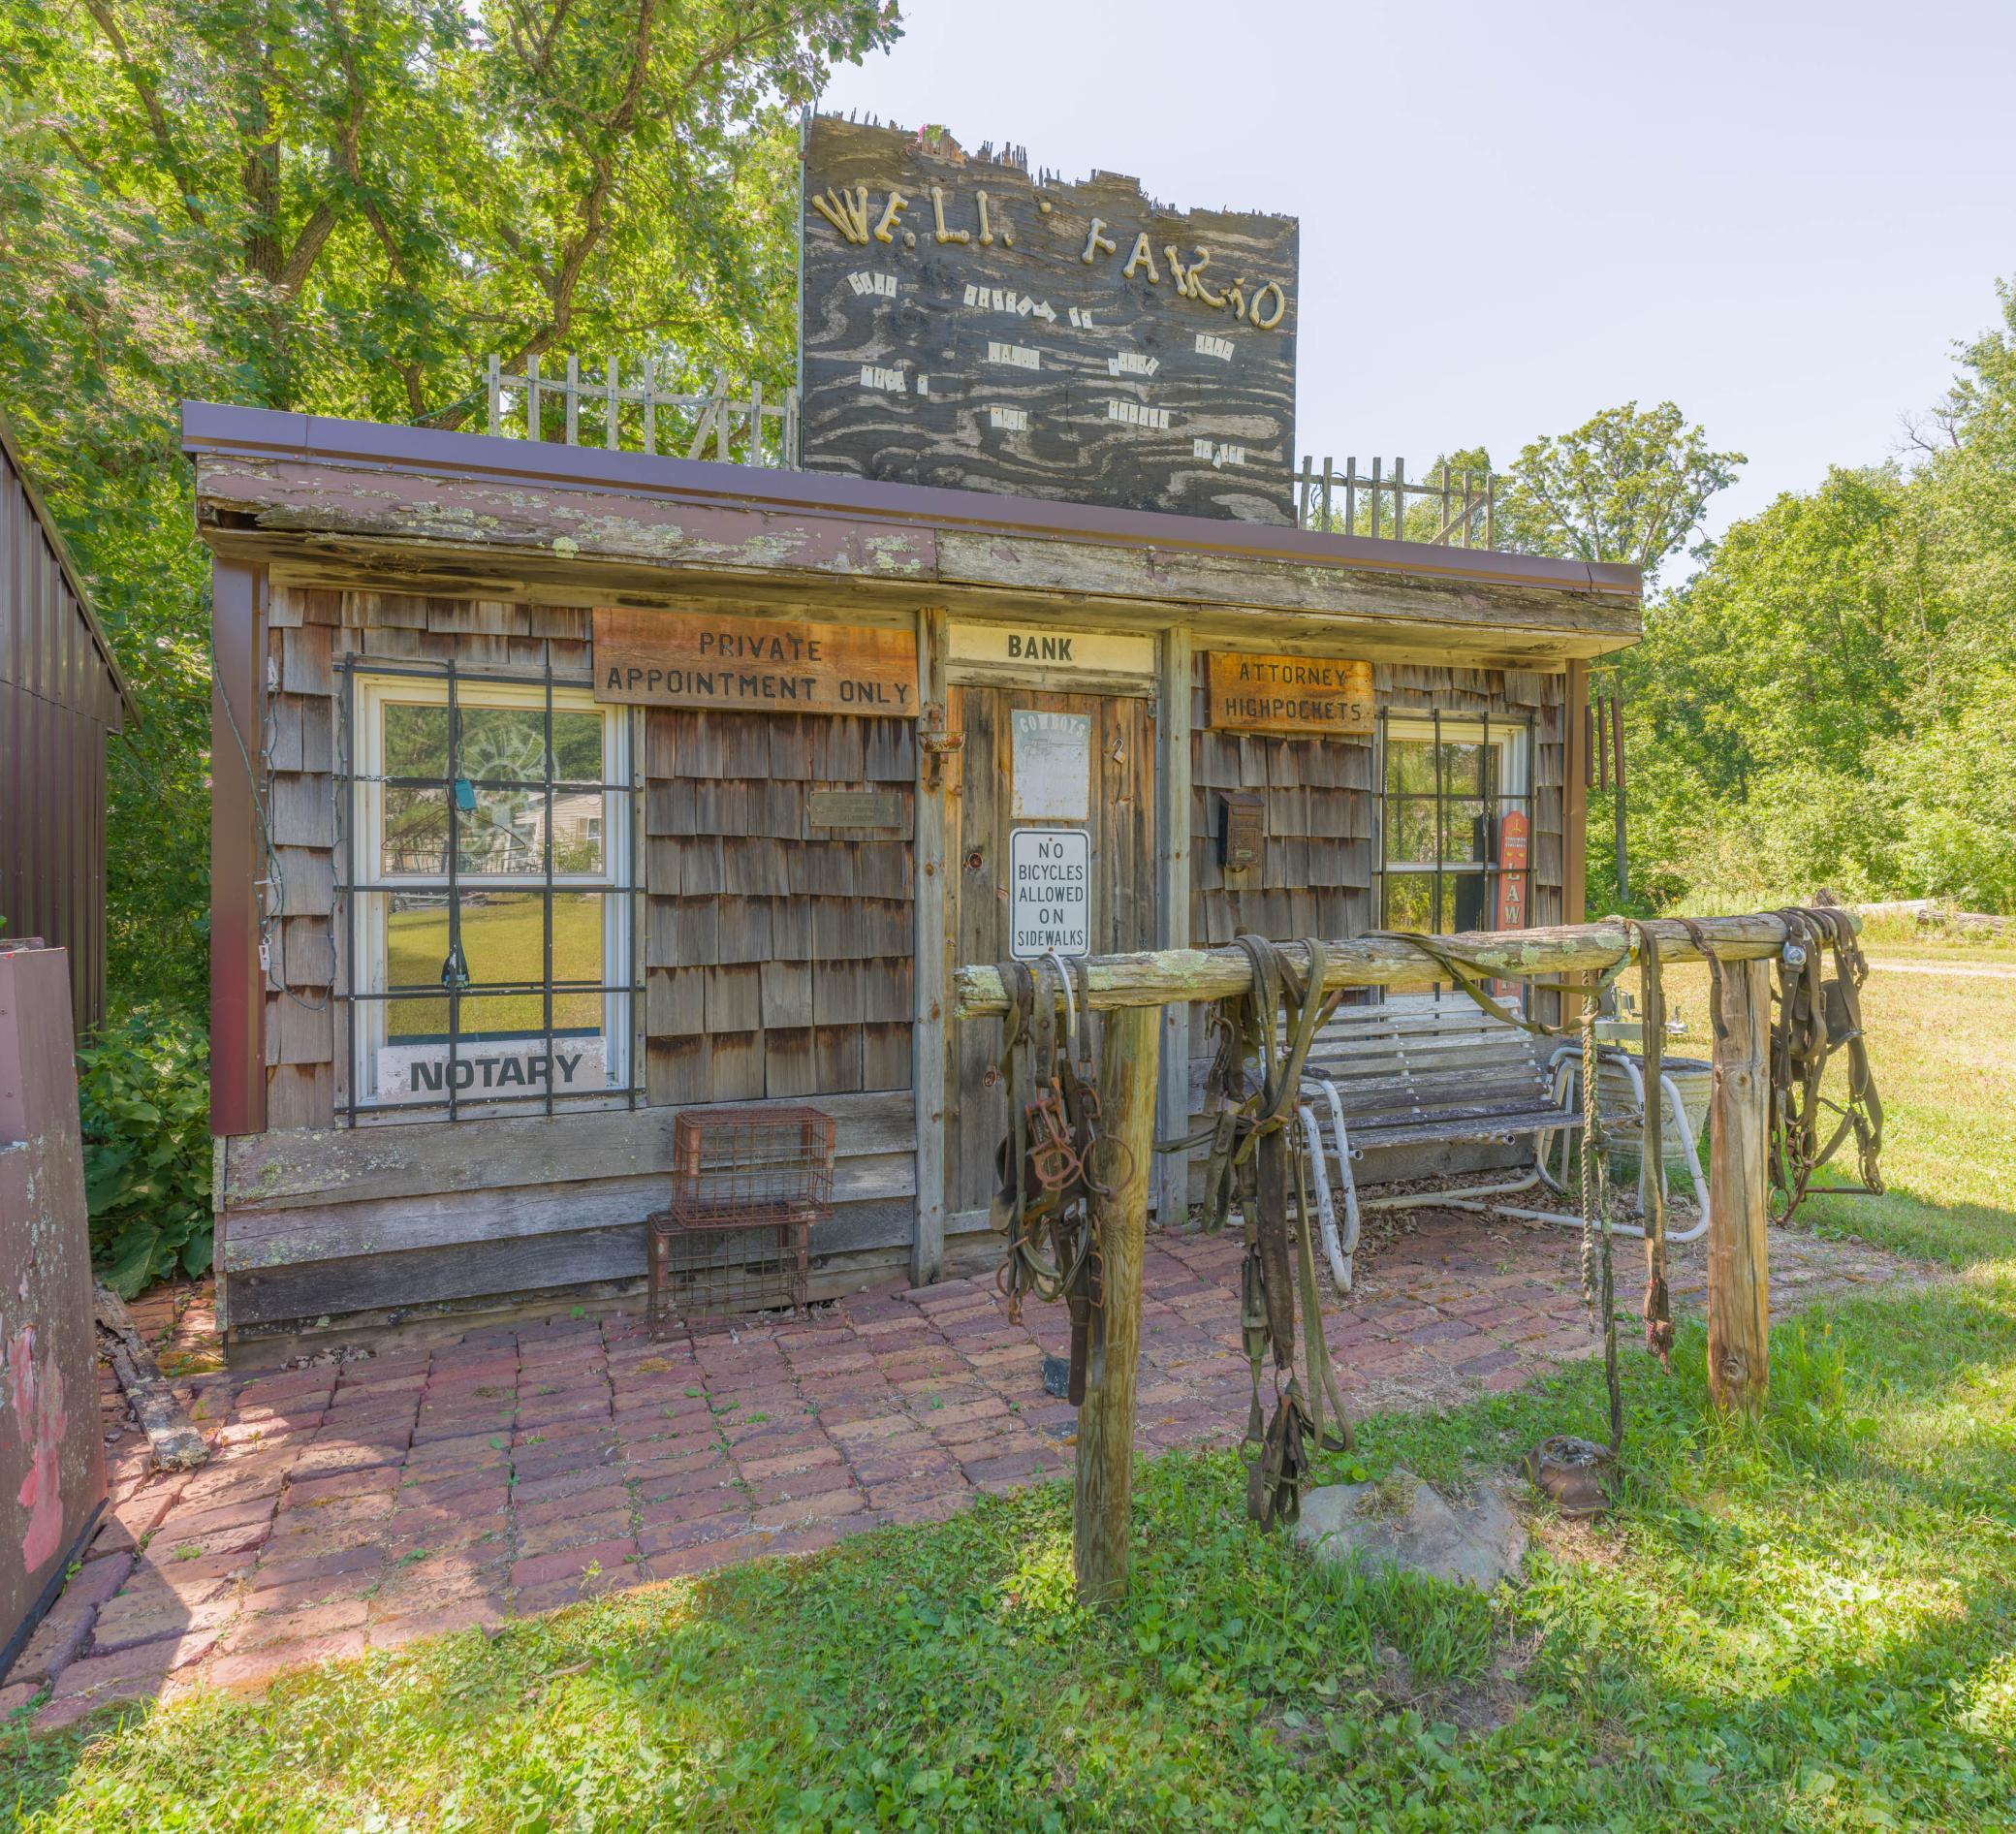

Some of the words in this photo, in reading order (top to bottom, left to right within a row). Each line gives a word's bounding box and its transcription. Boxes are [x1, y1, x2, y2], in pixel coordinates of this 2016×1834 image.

[700, 632, 822, 662] PRIVATE
[1008, 634, 1073, 661] BANK
[607, 667, 817, 701] APPOINTMENT
[839, 680, 909, 704] ONLY
[1240, 662, 1346, 687] ATTORNEY
[1225, 697, 1362, 722] HIGHPOCKETS
[1019, 712, 1086, 738] COWBOYS
[1038, 842, 1064, 859] NO
[1018, 865, 1084, 881] BICYCLES
[1018, 886, 1084, 902] ALLOWED
[1039, 908, 1064, 924] ON
[1017, 929, 1084, 947] SIDEWALKS
[410, 1054, 583, 1091] NOTARY
